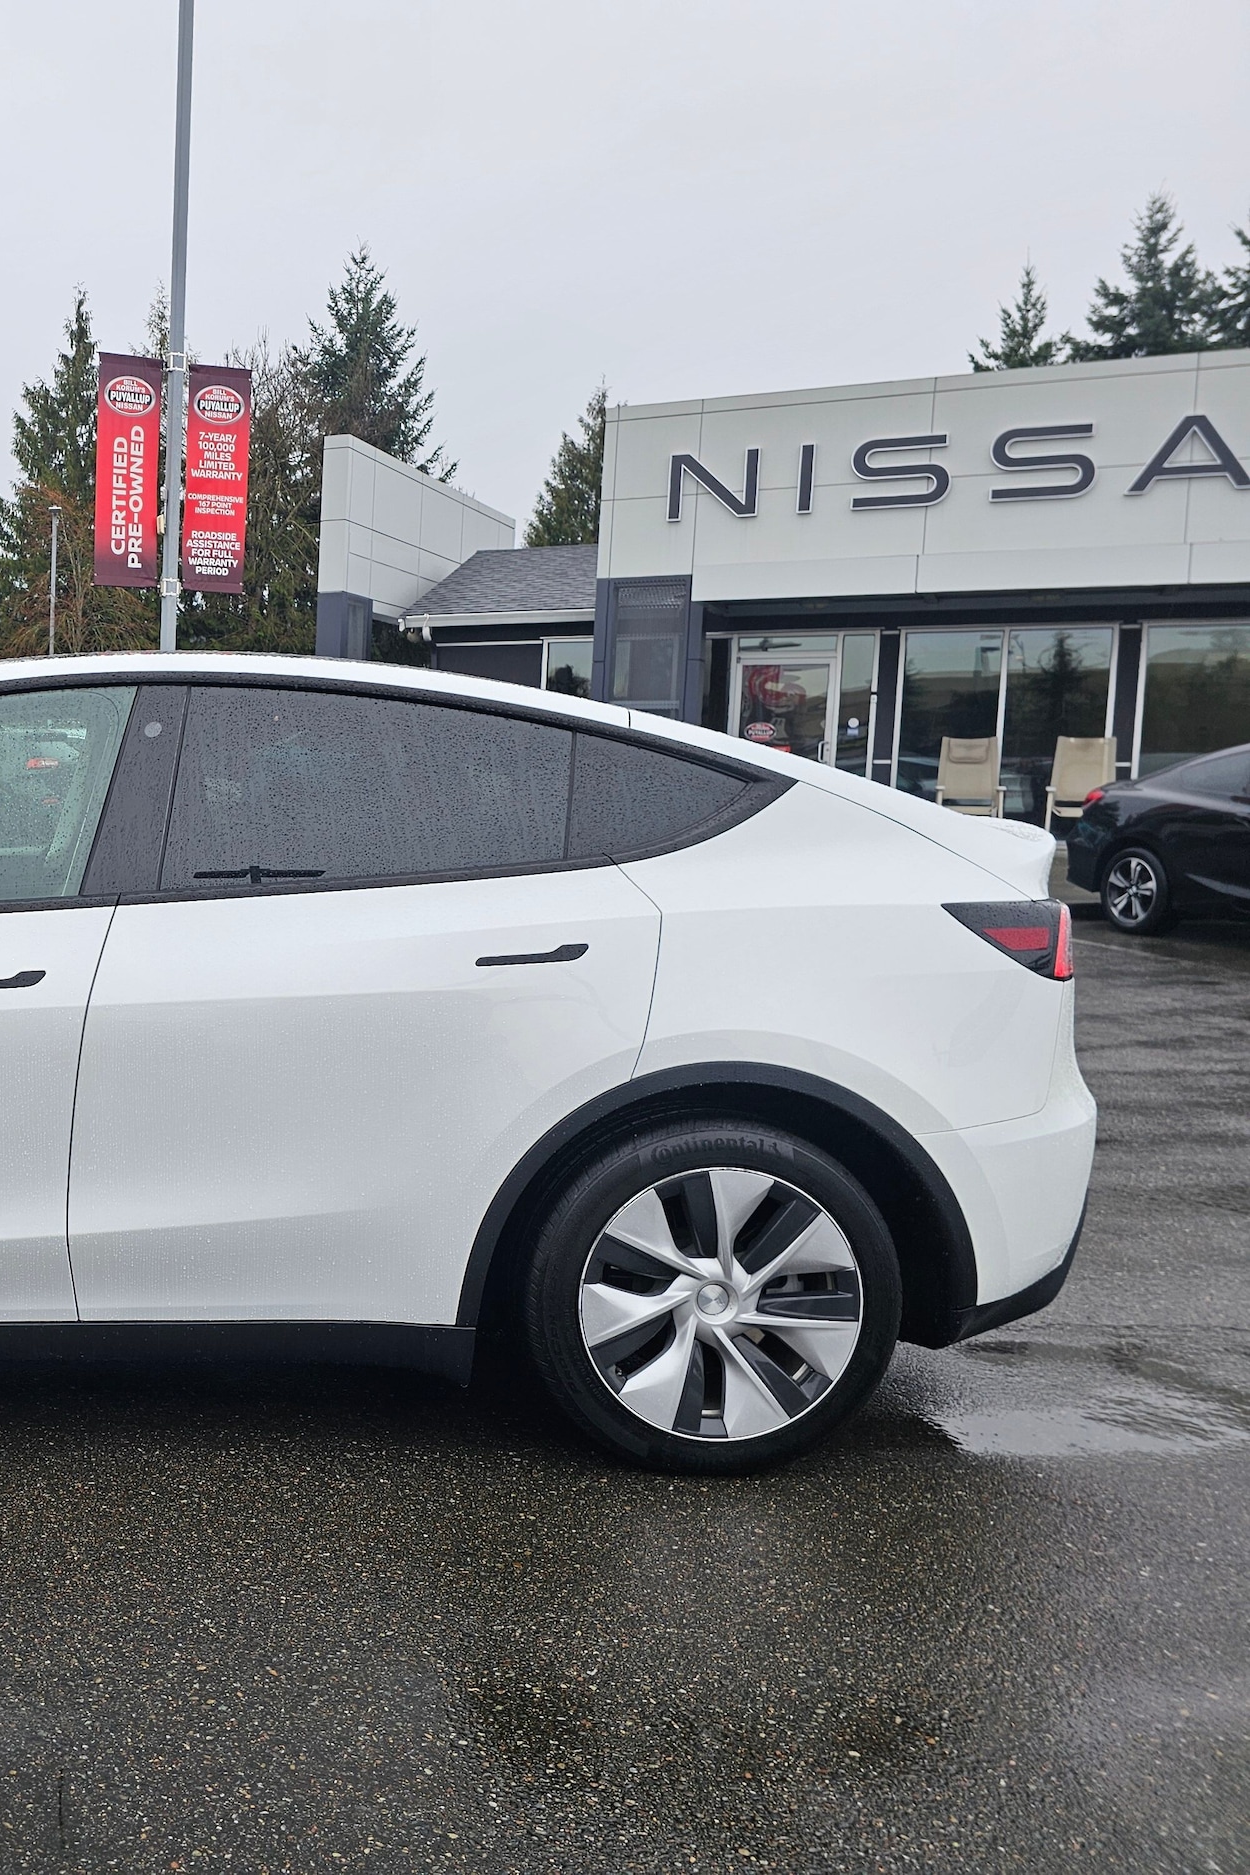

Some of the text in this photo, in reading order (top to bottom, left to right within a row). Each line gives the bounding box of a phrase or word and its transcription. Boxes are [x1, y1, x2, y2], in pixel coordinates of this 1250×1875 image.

[116, 384, 146, 393] KORUM'S
[123, 379, 138, 387] BILL
[110, 390, 151, 405] PUYALLUP
[205, 393, 235, 402] KORUM'S
[115, 402, 144, 411] NISSAN
[199, 400, 240, 413] PUYALLUP
[204, 411, 233, 419] NISSAN
[198, 431, 237, 444] 7-YEAR/
[198, 441, 236, 452] 100,000
[203, 451, 232, 461] MILES
[198, 460, 236, 471] LIMITED
[666, 413, 1250, 523] NISSA
[190, 468, 243, 481] WARRANTY
[111, 436, 128, 555] CERTIFIED
[127, 425, 145, 569] PRE-OWNED
[187, 492, 244, 504] COMPREHENSIVE
[211, 501, 232, 509] POINT
[194, 507, 236, 516] INSPECTION
[191, 530, 237, 541] ROADSIDE
[186, 539, 241, 550] ASSISTANCE
[191, 548, 234, 559] FOR FULL
[187, 556, 239, 568] WARRANTY
[195, 566, 229, 576] PERIOD
